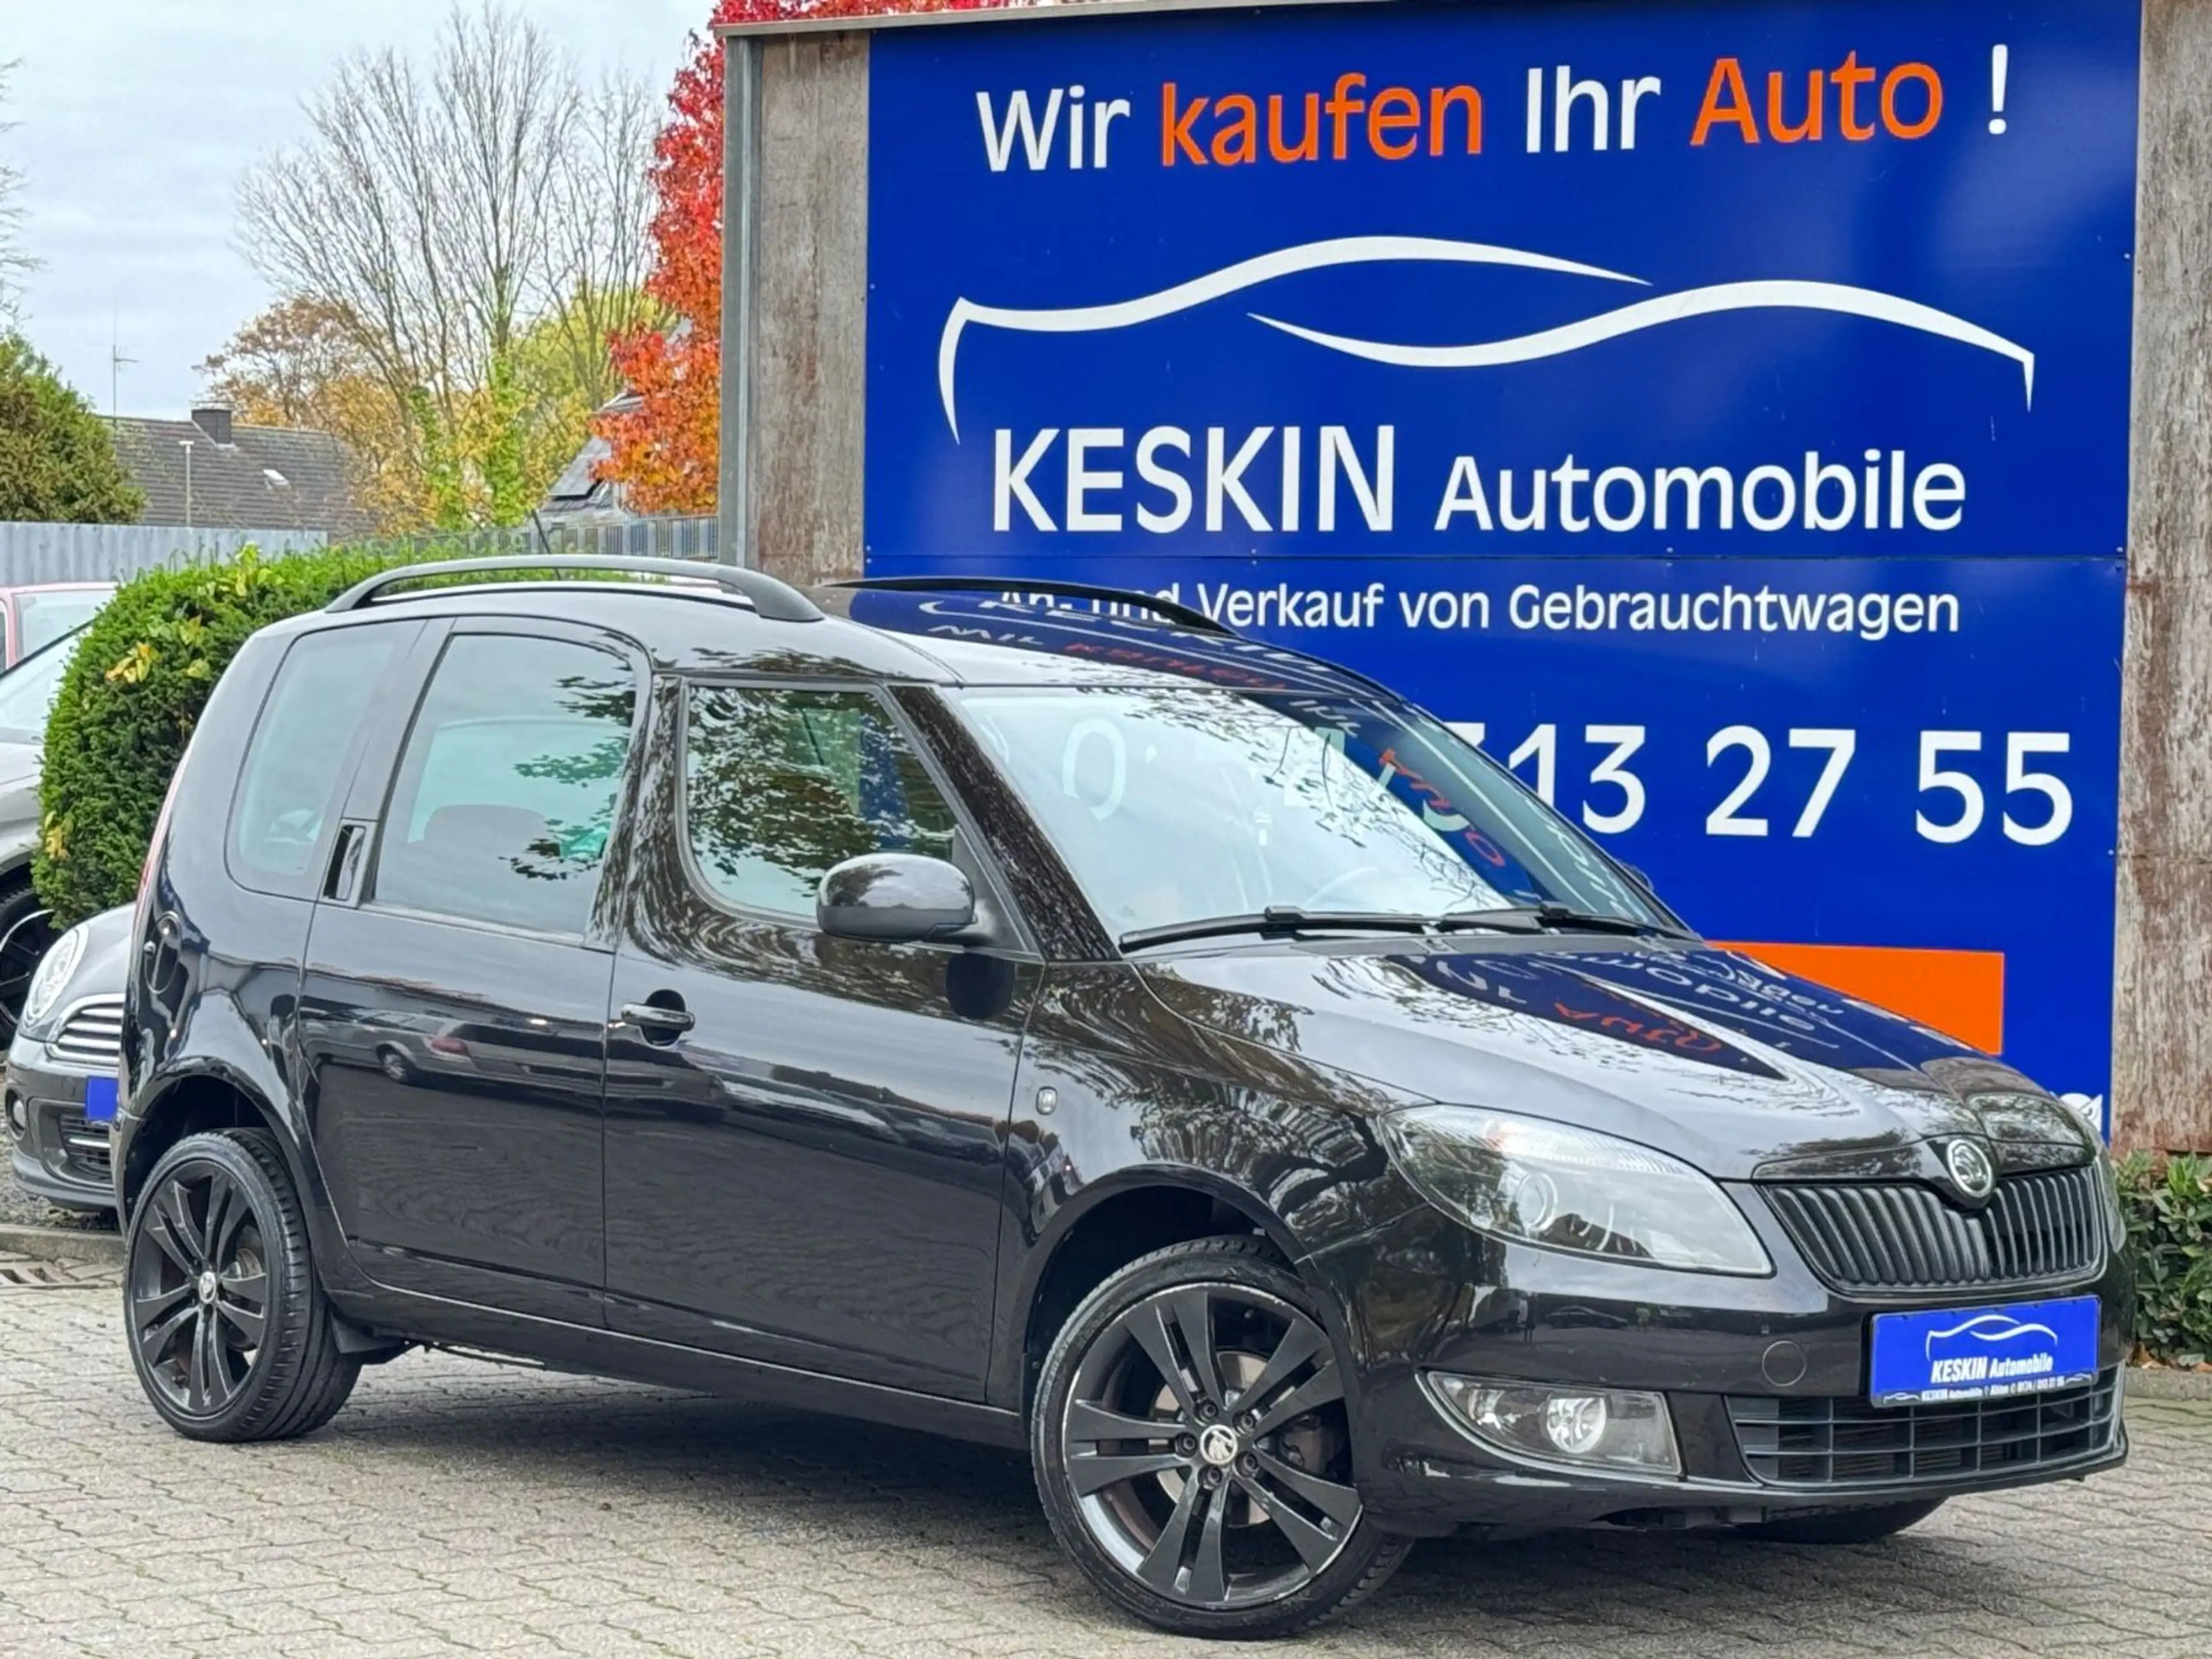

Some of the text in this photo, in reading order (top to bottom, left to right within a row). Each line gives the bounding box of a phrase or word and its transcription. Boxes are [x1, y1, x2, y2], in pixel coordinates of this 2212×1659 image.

[976, 85, 1131, 172] Wir
[1162, 73, 1483, 167] kaufen
[1526, 65, 1661, 153] Ihr
[1690, 50, 1944, 146] Auto
[993, 425, 1966, 534] KESKIN Automobile
[1197, 582, 1385, 628] Verkauf
[1399, 592, 1490, 629] von
[1509, 584, 1960, 642] Gebrauchtwagen
[1706, 725, 1856, 838] 27
[1916, 730, 2073, 846] 55
[1930, 1353, 2054, 1384] KESKIN Automobile
